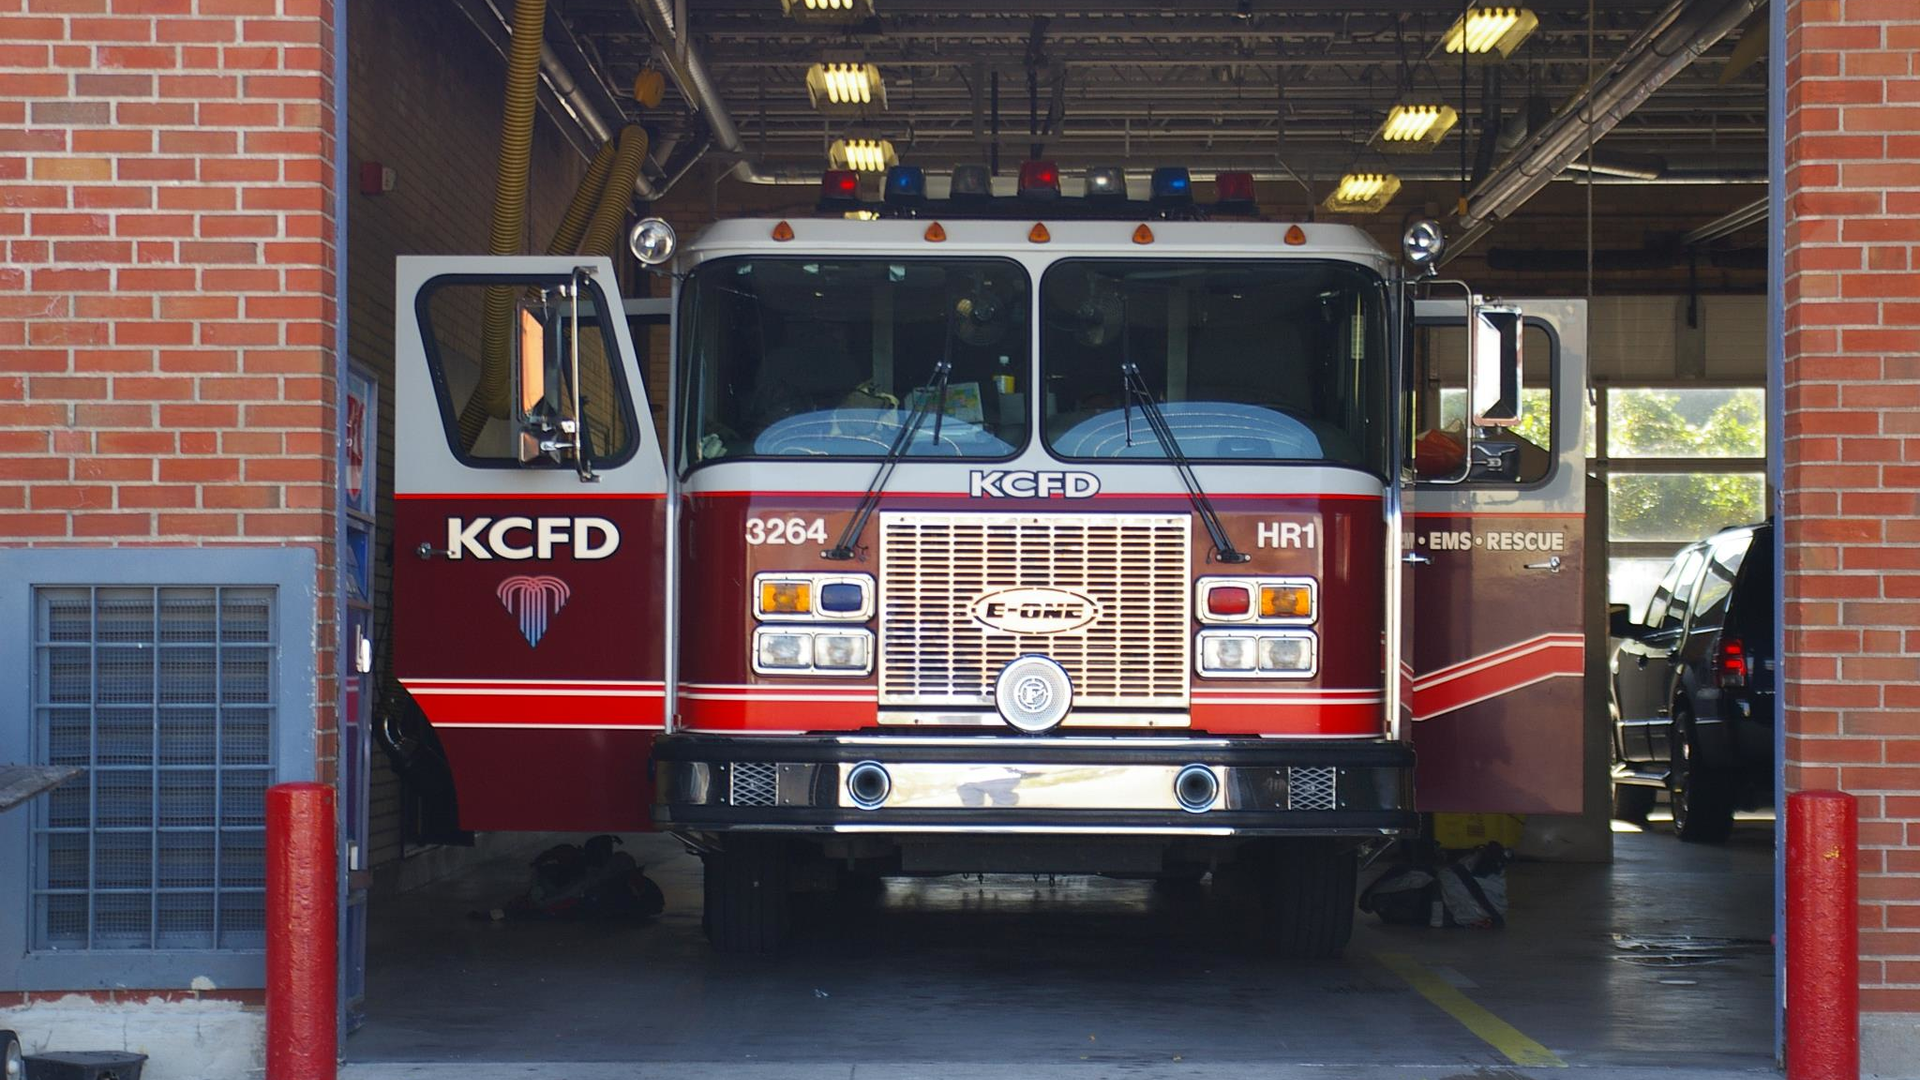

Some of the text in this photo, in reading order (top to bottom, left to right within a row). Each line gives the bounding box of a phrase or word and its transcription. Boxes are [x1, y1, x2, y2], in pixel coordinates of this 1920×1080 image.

[969, 470, 1101, 498] KCFD
[447, 516, 620, 560] KCFD
[745, 517, 828, 545] 3264
[1257, 522, 1315, 549] HR1
[1429, 531, 1472, 550] EMS
[1486, 531, 1565, 551] RESCUE
[985, 602, 1084, 619] E-ONE
